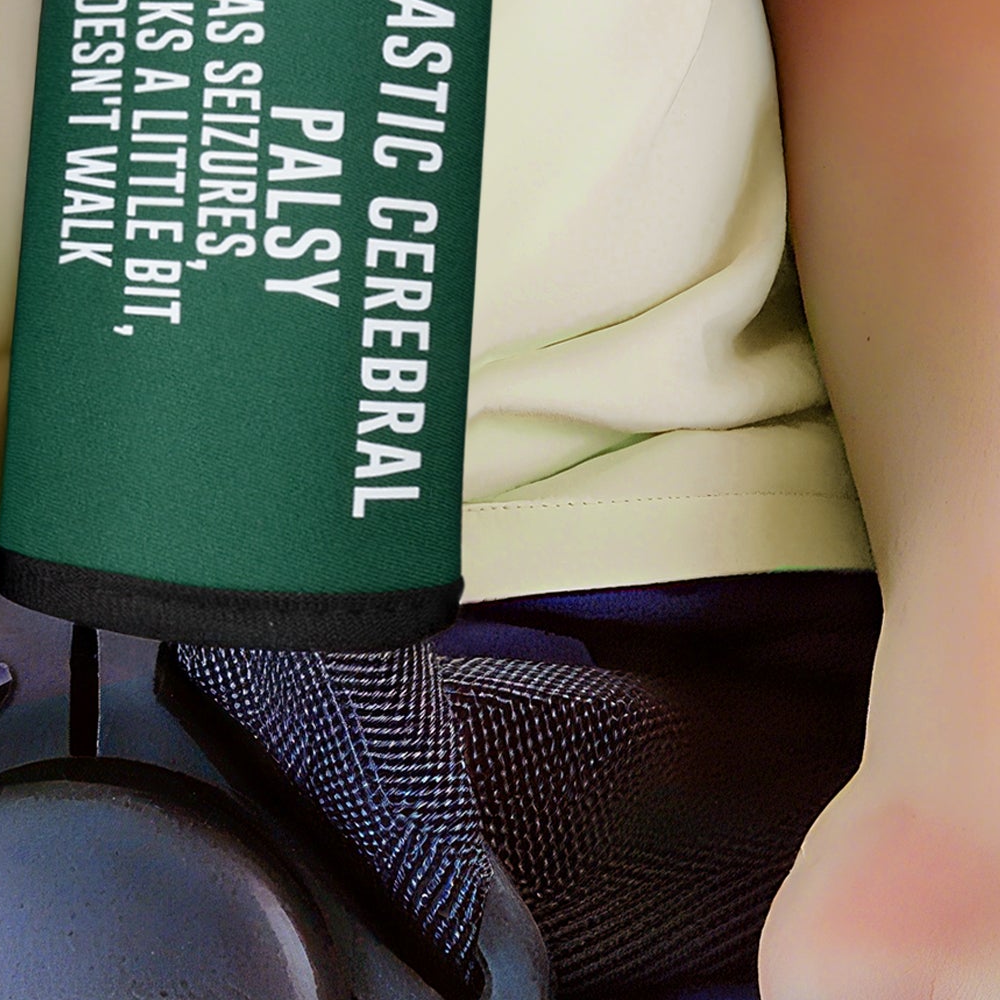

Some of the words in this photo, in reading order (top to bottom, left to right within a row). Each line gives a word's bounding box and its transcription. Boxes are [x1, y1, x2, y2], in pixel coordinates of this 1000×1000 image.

[134, 67, 191, 94] A
[59, 145, 118, 268] WALK
[126, 109, 189, 243] LITTLE
[186, 61, 263, 271] SEIZURES,
[264, 106, 345, 308] PALSY
[114, 257, 182, 336] BIT,
[353, 196, 439, 518] CEREBRAL
